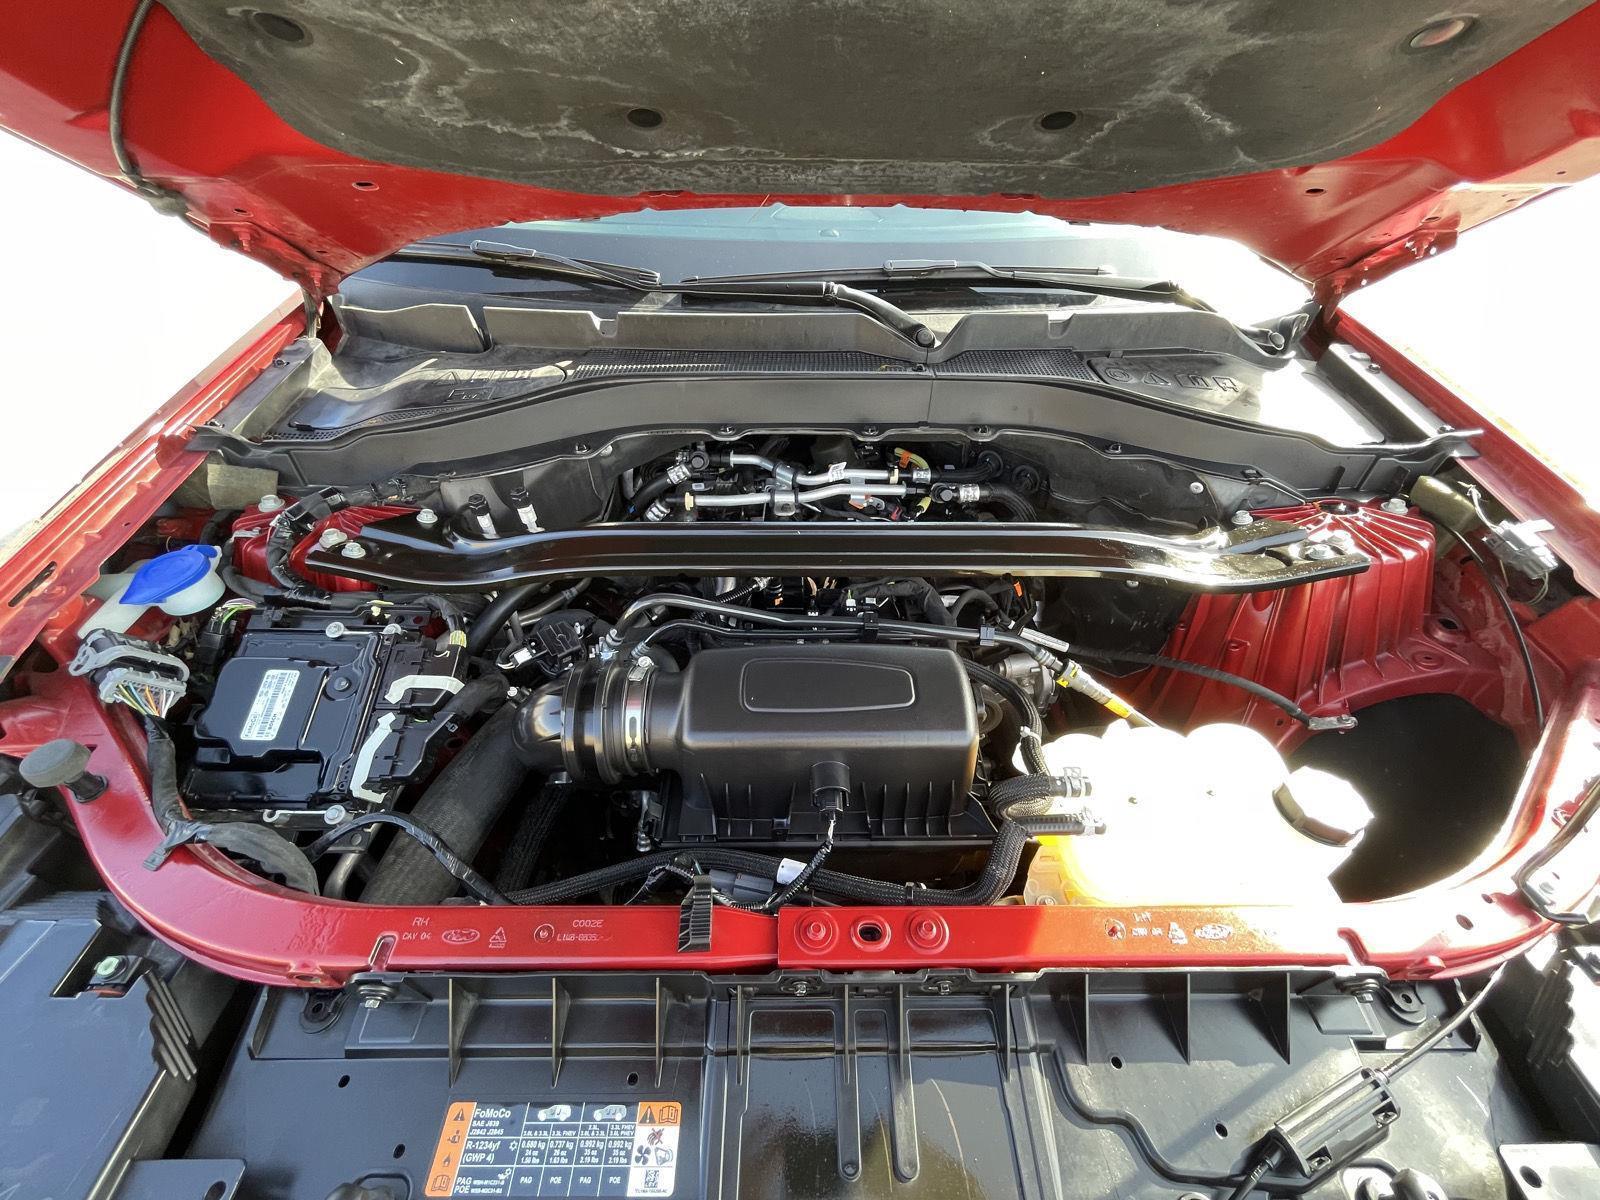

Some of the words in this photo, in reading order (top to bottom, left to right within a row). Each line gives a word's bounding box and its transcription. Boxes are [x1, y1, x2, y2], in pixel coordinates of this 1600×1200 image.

[473, 1108, 512, 1118] FoMoCo
[465, 1140, 501, 1151] R-1234yf
[537, 1140, 546, 1150] kg
[565, 1140, 574, 1150] kg
[596, 1140, 604, 1150] kg
[624, 1140, 633, 1150] kg
[462, 1153, 486, 1164] (GWP
[486, 1153, 495, 1164] 4)
[456, 1176, 472, 1185] PAG
[520, 1176, 533, 1184] PAG
[549, 1176, 562, 1184] POE
[579, 1176, 592, 1184] PAG
[608, 1176, 622, 1184] POE
[454, 1185, 470, 1194] POE
